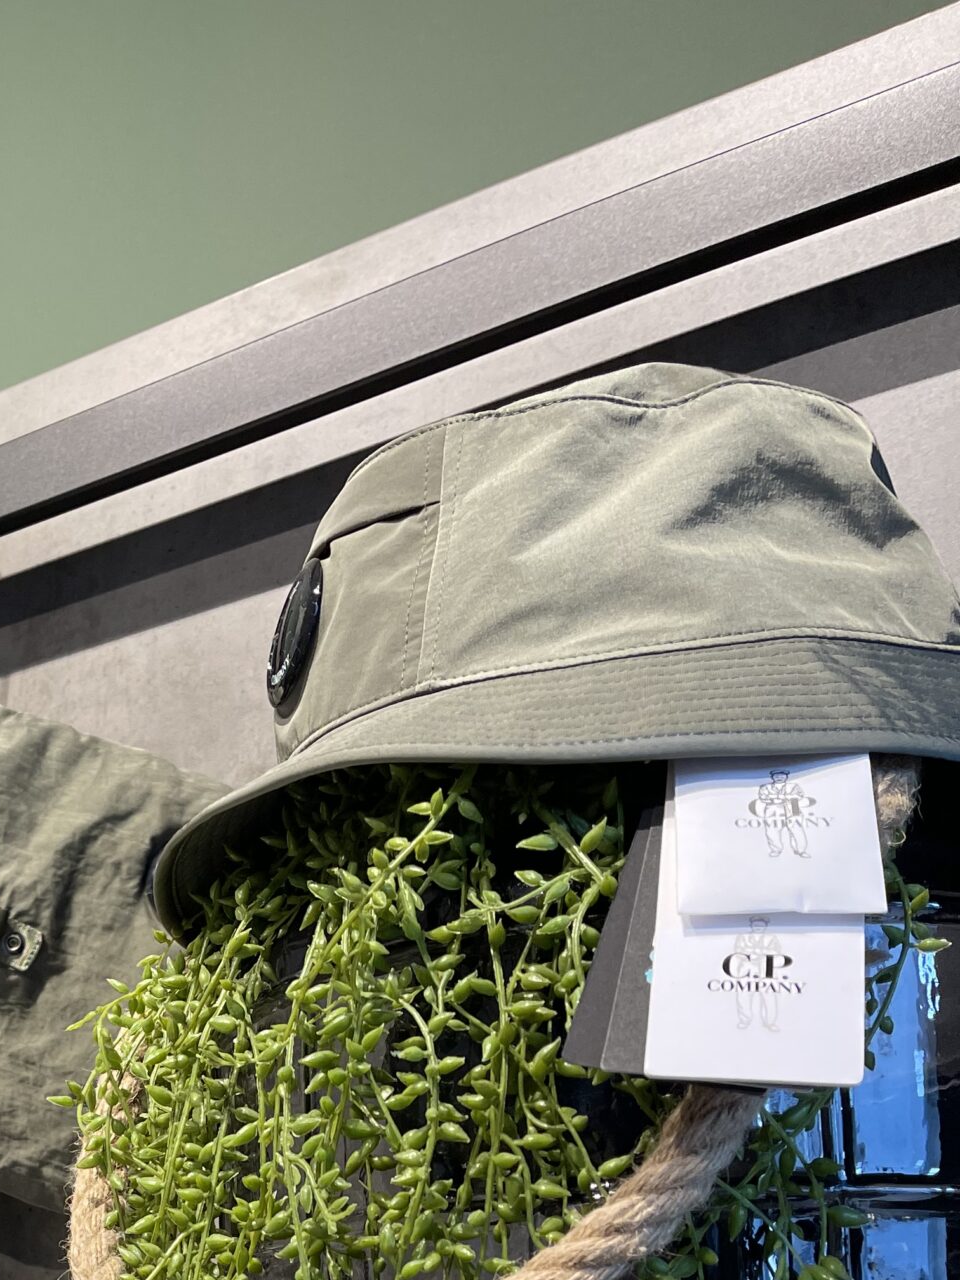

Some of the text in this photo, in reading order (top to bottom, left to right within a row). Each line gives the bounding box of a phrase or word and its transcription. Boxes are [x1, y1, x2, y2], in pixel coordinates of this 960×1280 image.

[748, 796, 817, 818] C.P.
[734, 816, 833, 829] COMPANY
[722, 952, 793, 980] C.P.
[707, 978, 807, 995] COMPANY
